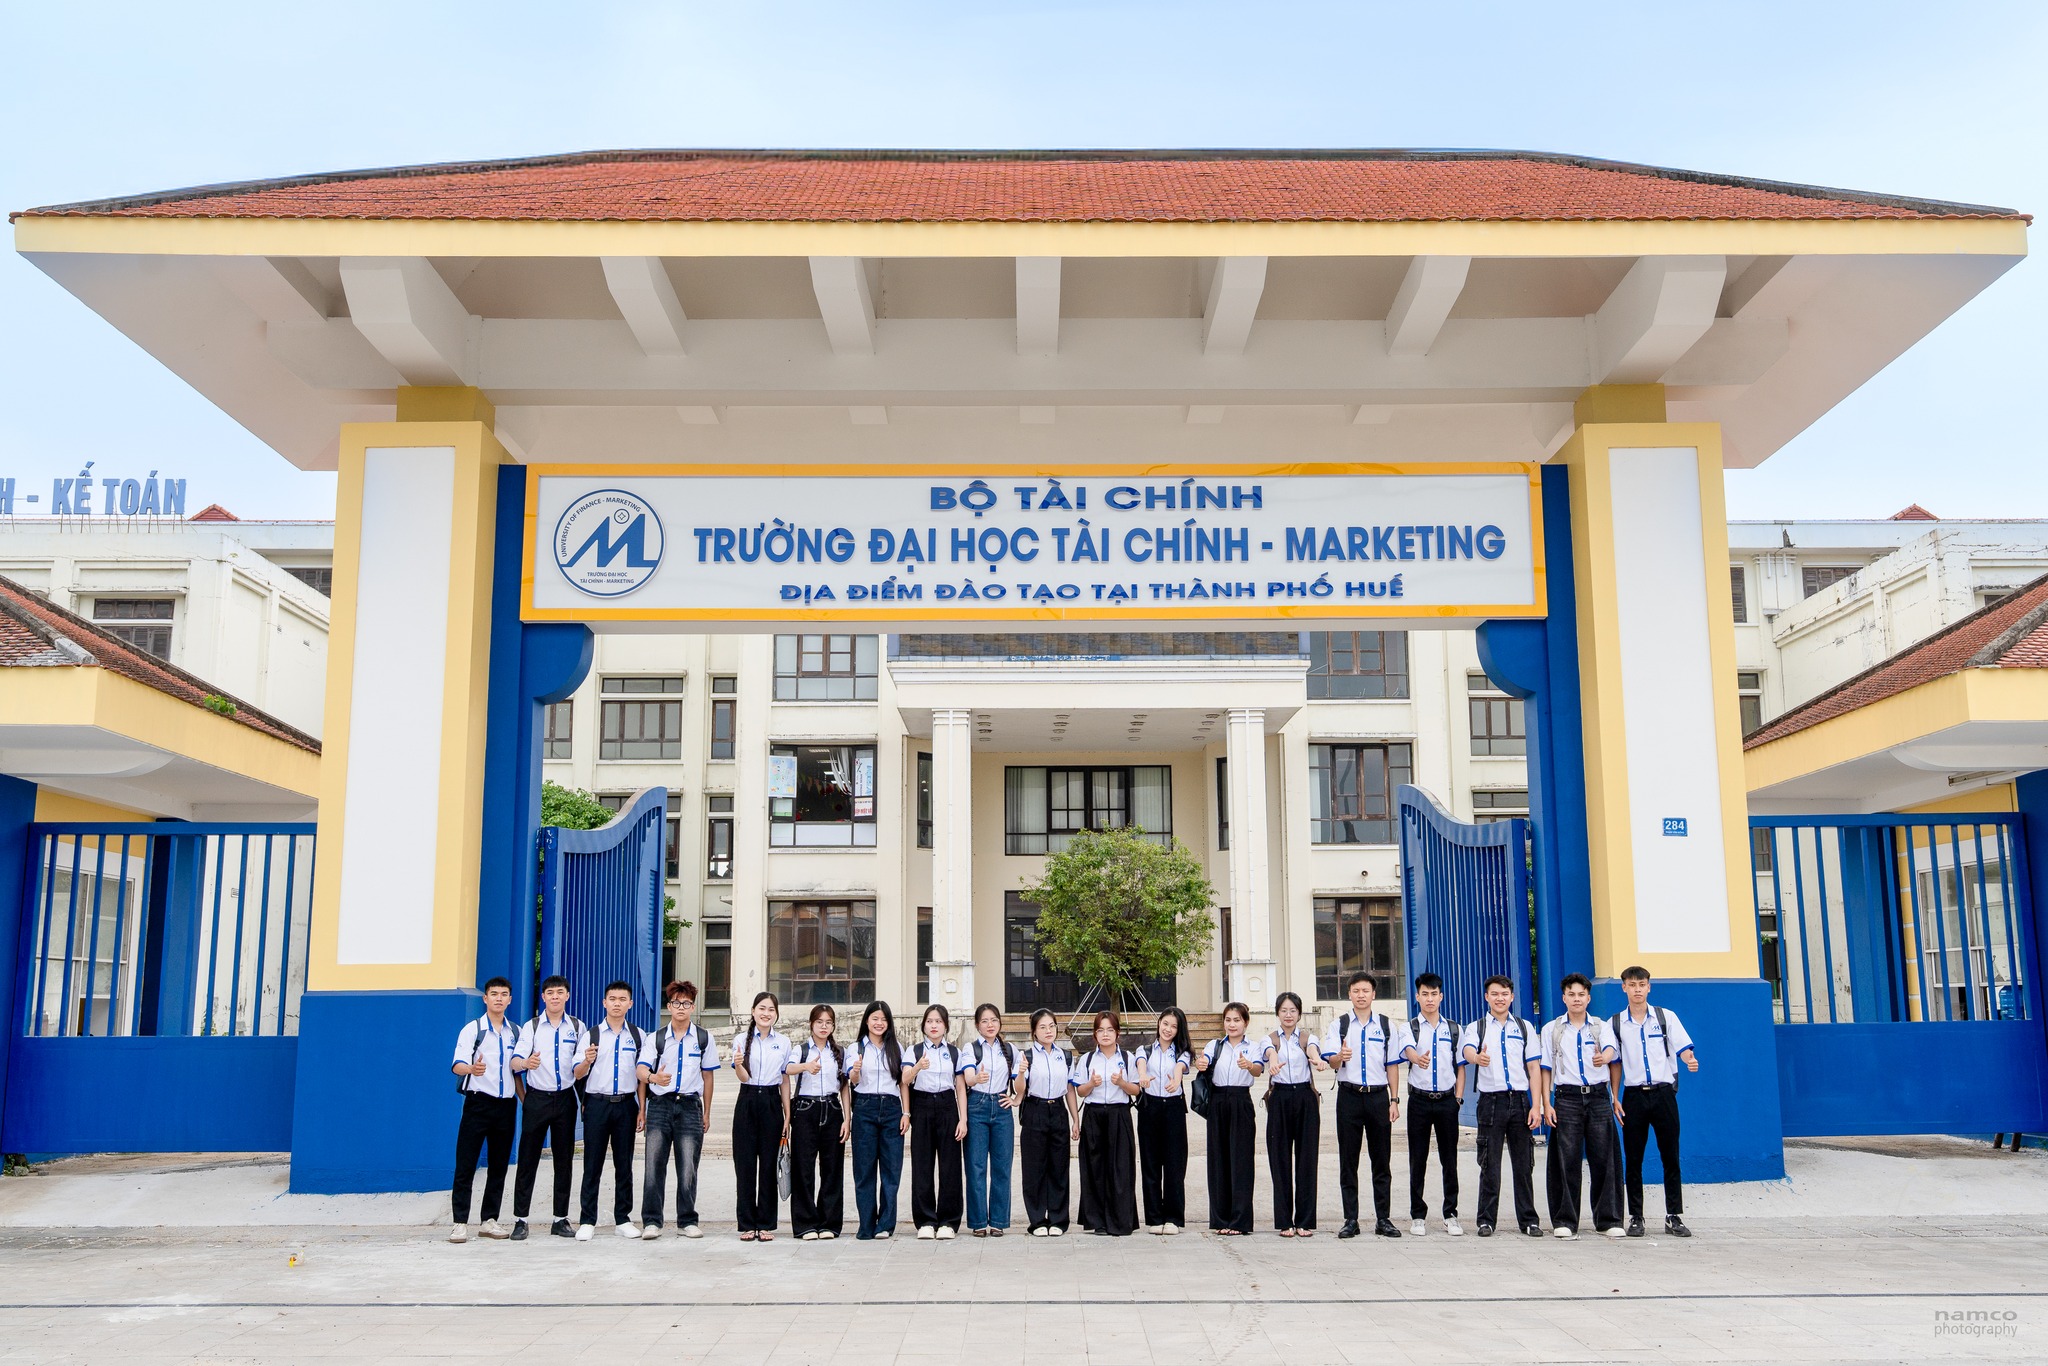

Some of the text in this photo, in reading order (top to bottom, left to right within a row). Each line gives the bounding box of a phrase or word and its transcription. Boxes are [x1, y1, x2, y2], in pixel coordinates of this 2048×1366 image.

[52, 461, 95, 515] KẾ
[102, 470, 187, 515] TOÁN
[930, 478, 1263, 517] BỘ TÀI CHÍNH
[560, 522, 573, 557] UNIVERSITY
[569, 513, 578, 522] OF
[576, 498, 602, 516] FINANCE
[605, 497, 642, 513] MARKETING
[694, 518, 1507, 572] TRƯỜNG ĐẠI HỌC TÀI CHÍNH - MARKETING
[780, 572, 1404, 605] ĐỊA ĐIỂM ĐÀO TẠO TẠI THÀNH PHỐ HUẾ
[1665, 820, 1685, 830] 284
